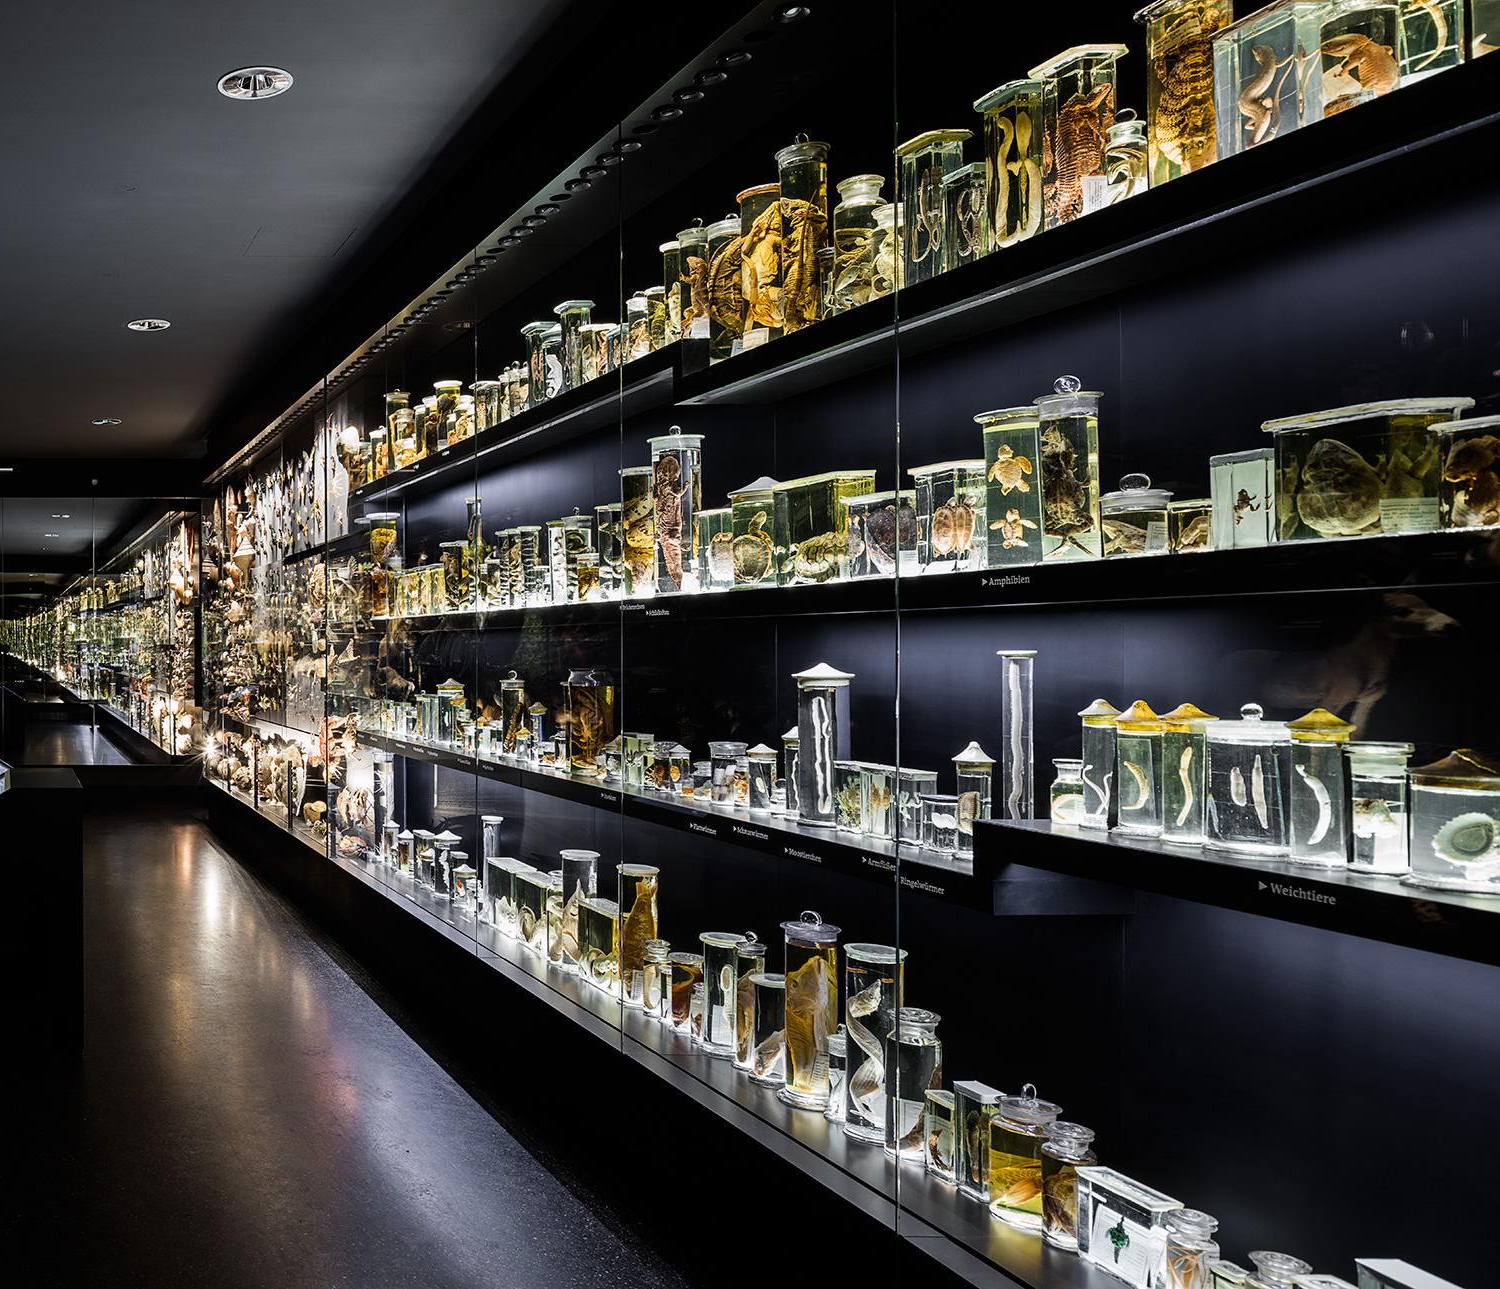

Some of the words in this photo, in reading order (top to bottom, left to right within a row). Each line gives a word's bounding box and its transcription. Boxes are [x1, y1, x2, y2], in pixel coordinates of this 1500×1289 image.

[988, 575, 1031, 588] Amphibien
[900, 875, 945, 895] Ringelwürmer
[1270, 883, 1336, 905] Weichtiere
